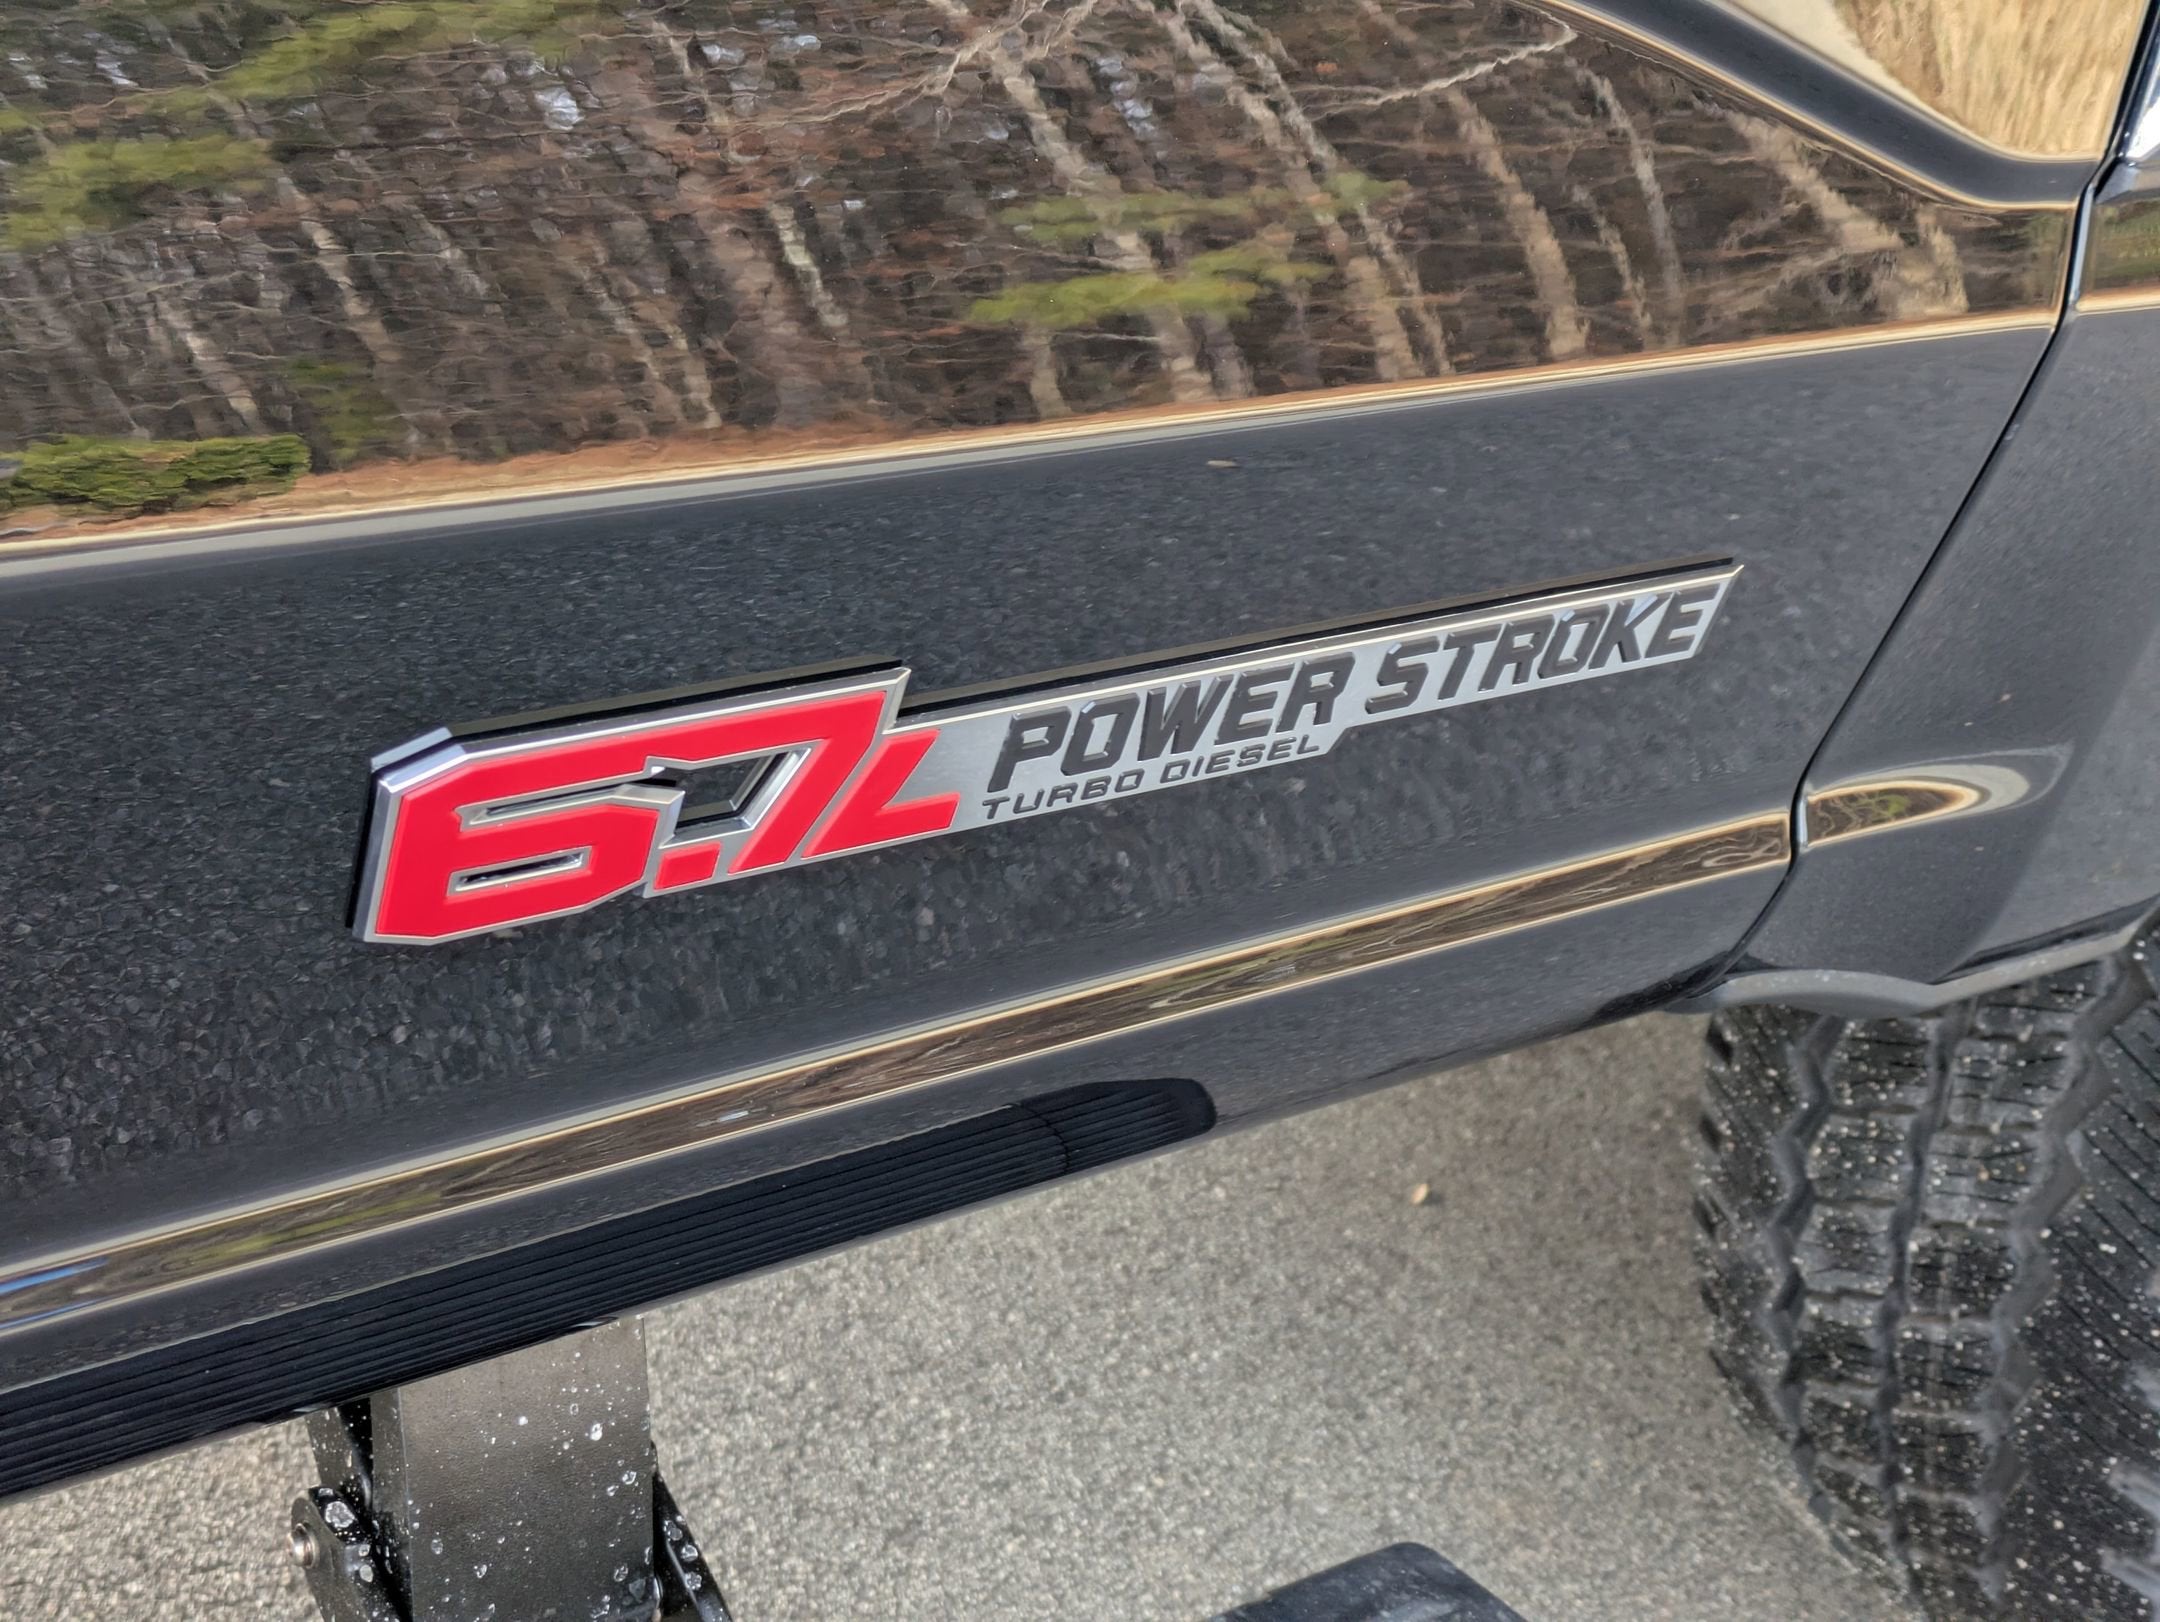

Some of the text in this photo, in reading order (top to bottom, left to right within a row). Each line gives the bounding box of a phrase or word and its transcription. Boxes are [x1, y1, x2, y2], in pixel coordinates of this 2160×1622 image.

[374, 584, 1720, 937] 6.7L POWER STROKE
[982, 734, 1320, 820] TURBO DIESEL
